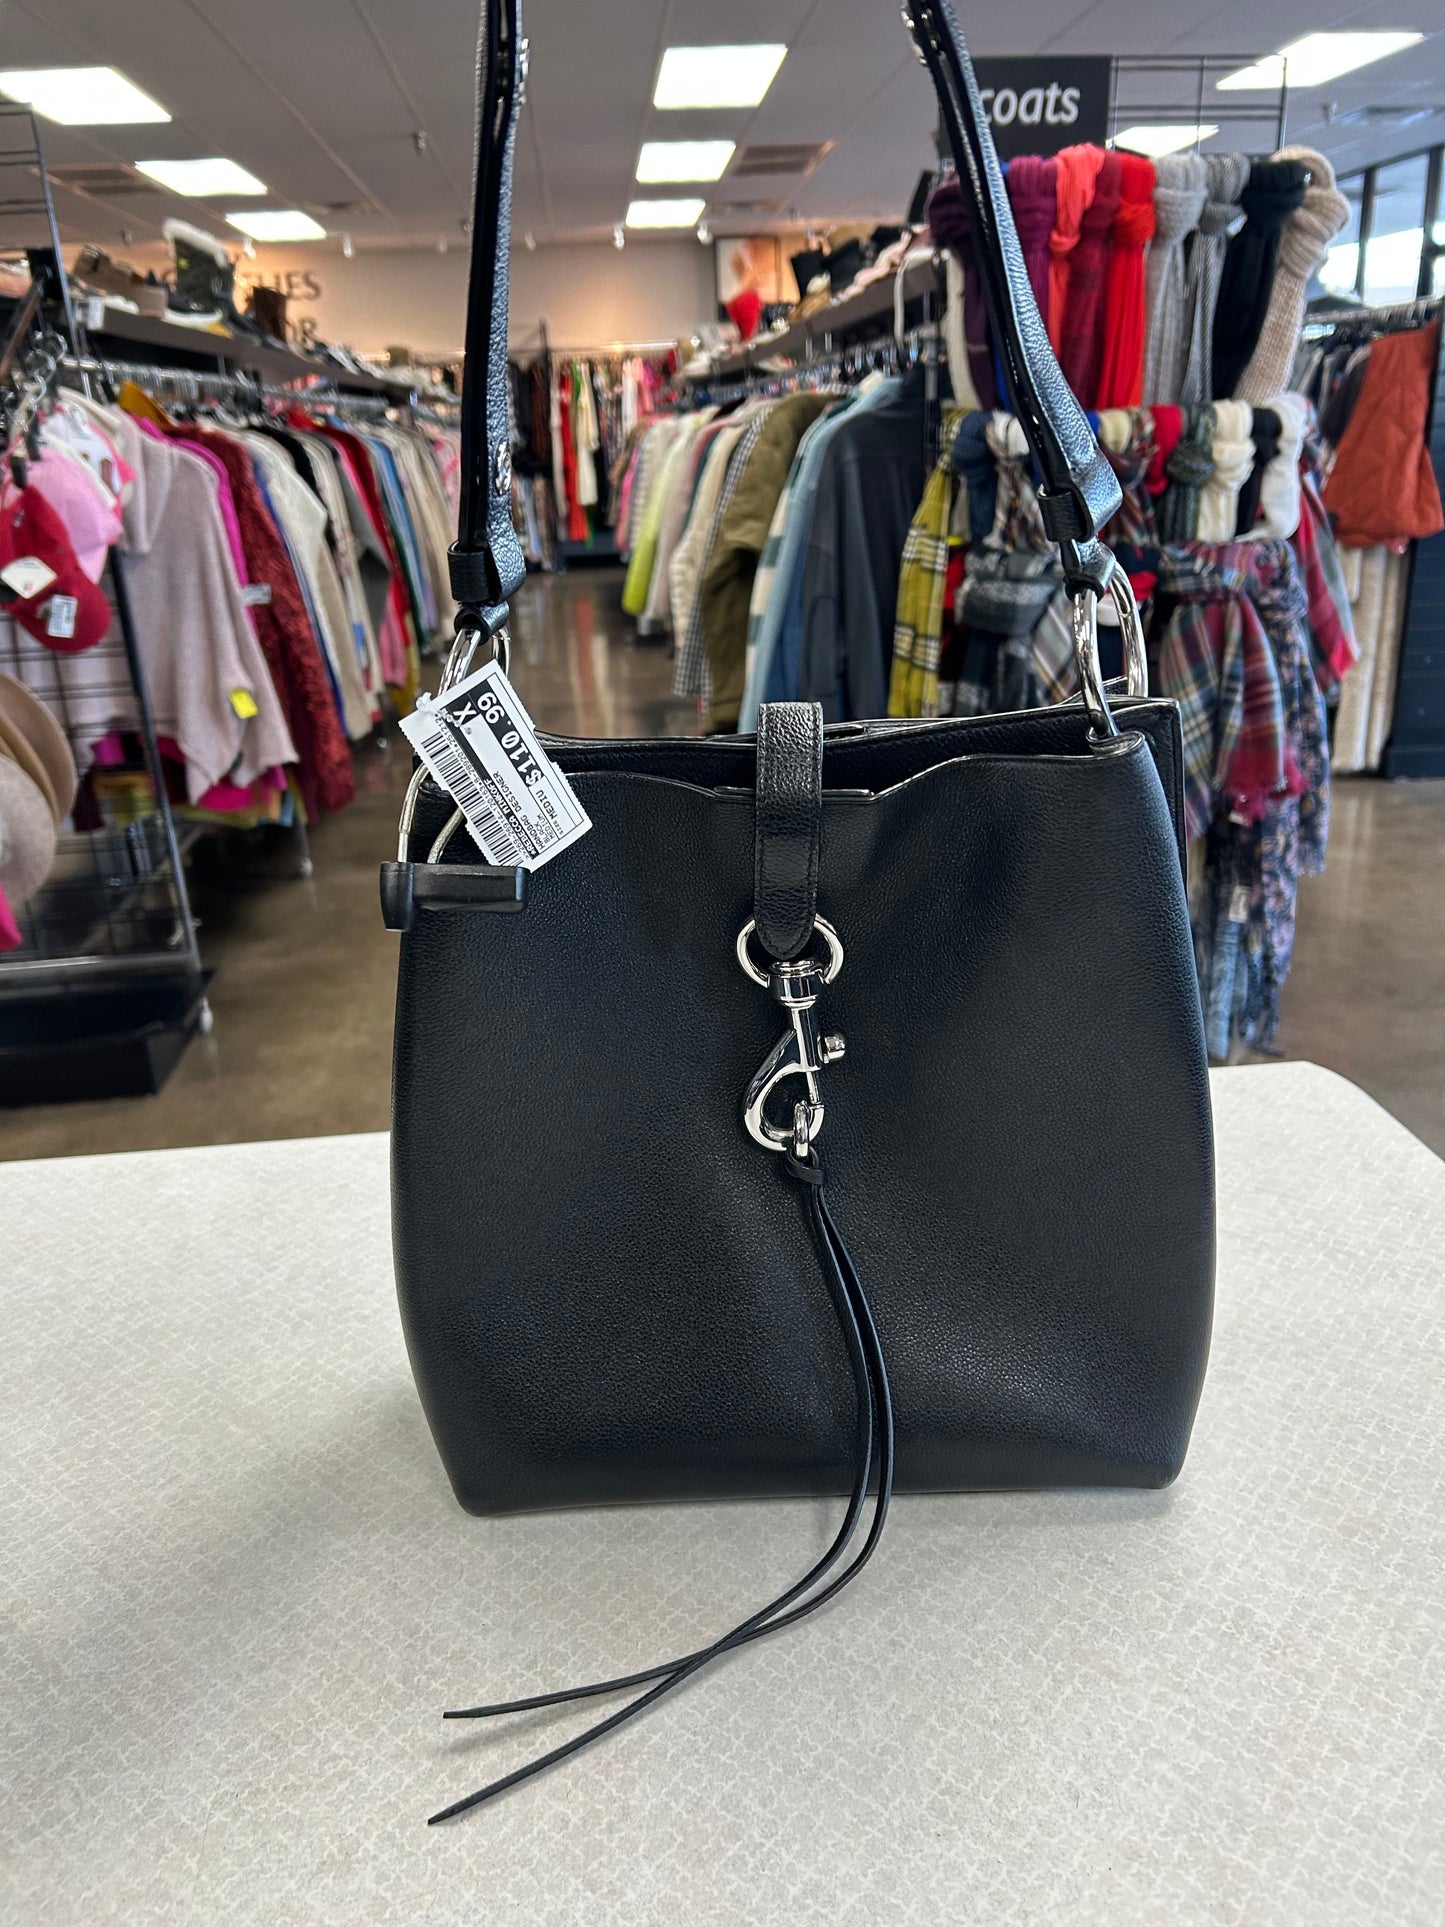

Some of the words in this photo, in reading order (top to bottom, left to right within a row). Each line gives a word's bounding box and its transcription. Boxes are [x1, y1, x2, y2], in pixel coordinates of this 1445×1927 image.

[452, 701, 476, 724] X
[475, 689, 543, 786] $110.99
[483, 777, 510, 813] MINKOFF
[492, 771, 521, 812] DESIGNER
[535, 789, 557, 819] MEDIU
[508, 815, 534, 851] REBECCA
[520, 814, 545, 849] HANDBAG
[533, 820, 550, 843] BLACK
[536, 813, 555, 839] MEDIUM
